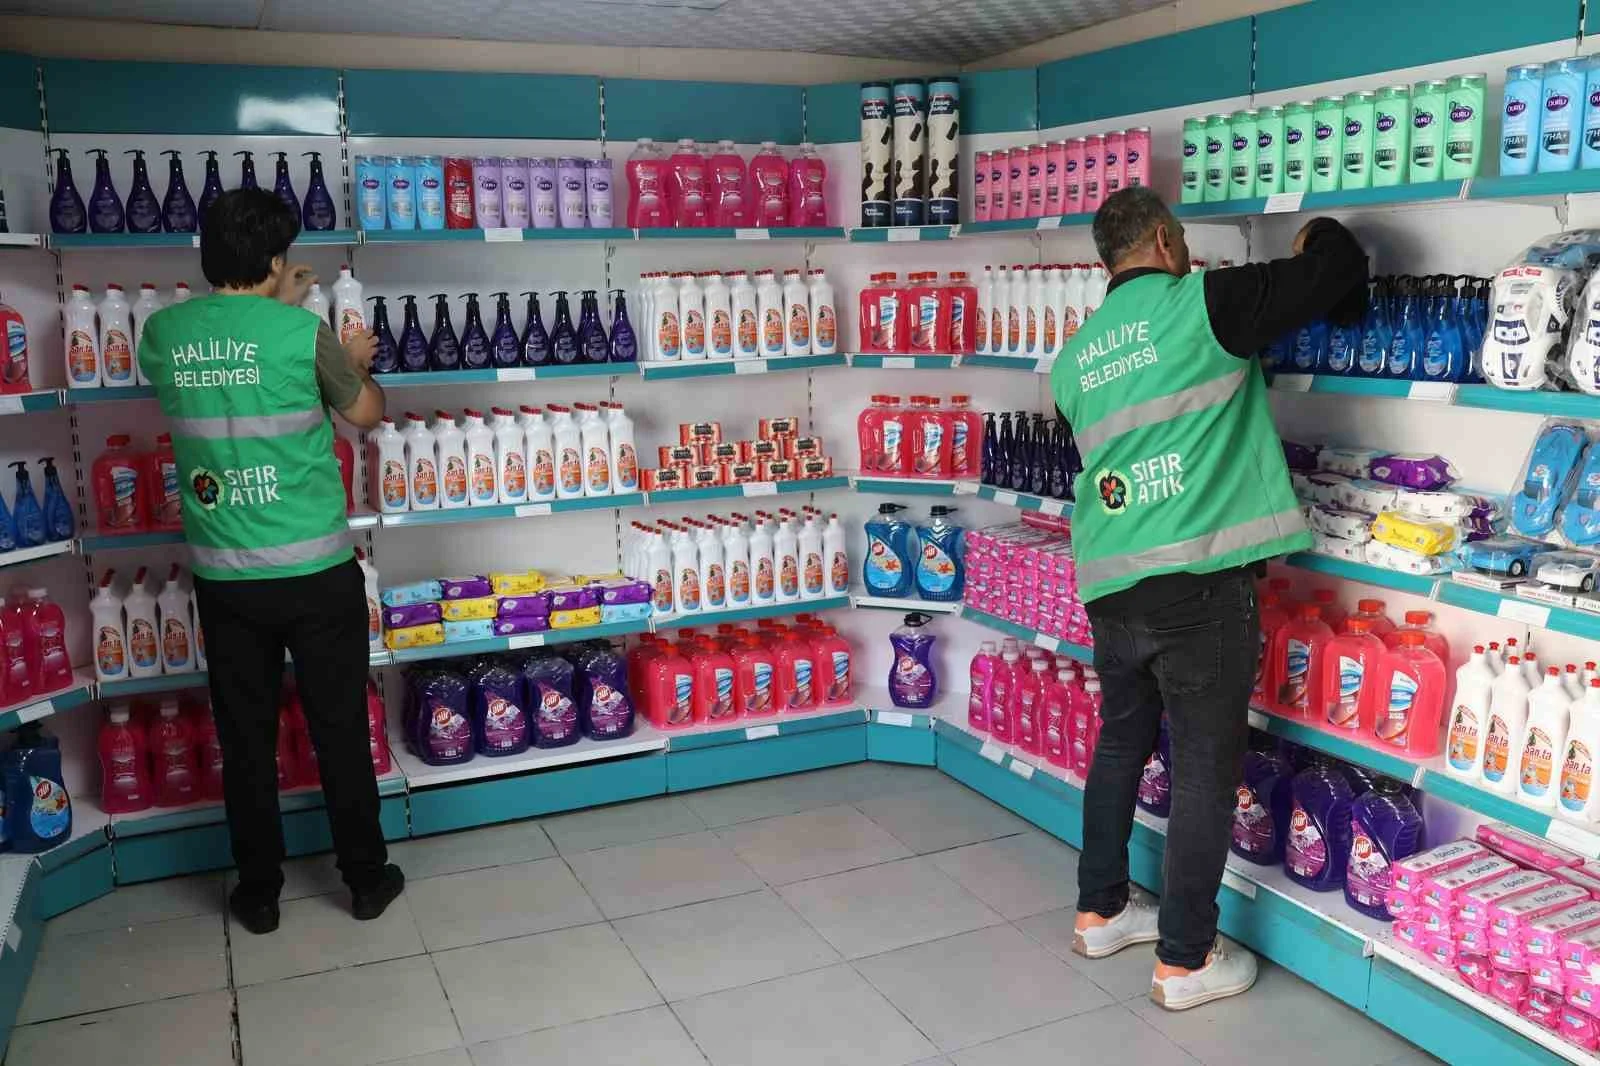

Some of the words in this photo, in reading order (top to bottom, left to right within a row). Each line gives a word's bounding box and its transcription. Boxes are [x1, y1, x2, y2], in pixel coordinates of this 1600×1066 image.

[224, 465, 278, 487] SIFIR
[1131, 453, 1184, 483] SIFIR
[230, 483, 281, 506] ATIK
[1137, 474, 1184, 504] ATIK
